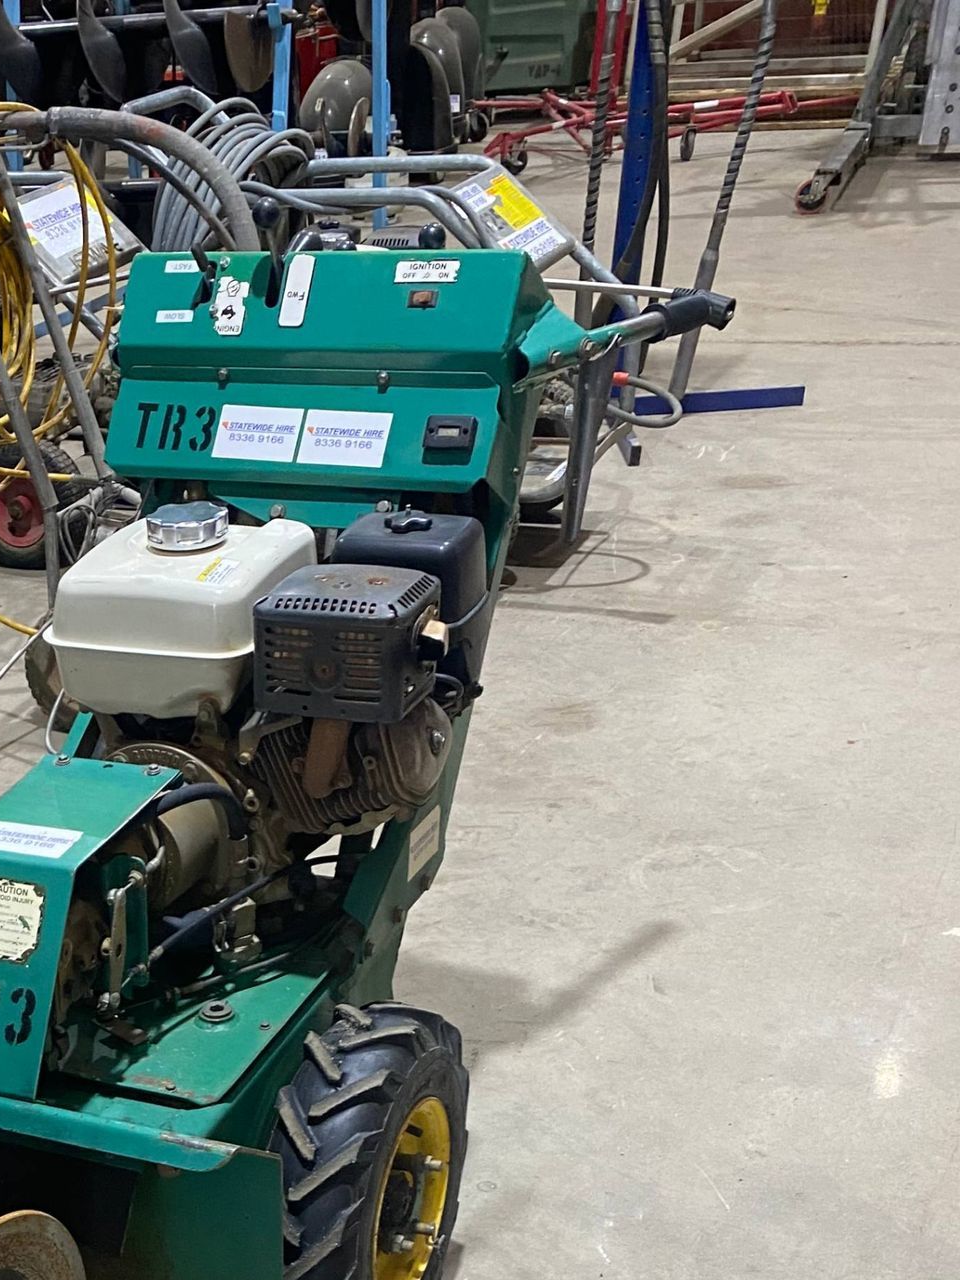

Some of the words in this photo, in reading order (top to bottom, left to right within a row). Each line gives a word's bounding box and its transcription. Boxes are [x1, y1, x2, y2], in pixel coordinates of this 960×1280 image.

[32, 206, 69, 230] STATEWIDE
[70, 203, 82, 215] HI
[173, 263, 193, 271] FAST
[409, 262, 448, 271] IGNITION
[286, 291, 306, 301] FWD
[163, 312, 186, 321] SLOW
[135, 402, 217, 452] TR3
[227, 421, 274, 433] STATEWIDE
[275, 424, 297, 434] HIRE
[313, 426, 361, 438] STATEWIDE
[362, 428, 385, 439] HIRE
[228, 432, 255, 443] 8336
[258, 434, 285, 445] 9166
[314, 437, 342, 448] 8336
[344, 439, 373, 450] 9166
[11, 896, 34, 905] INJURY
